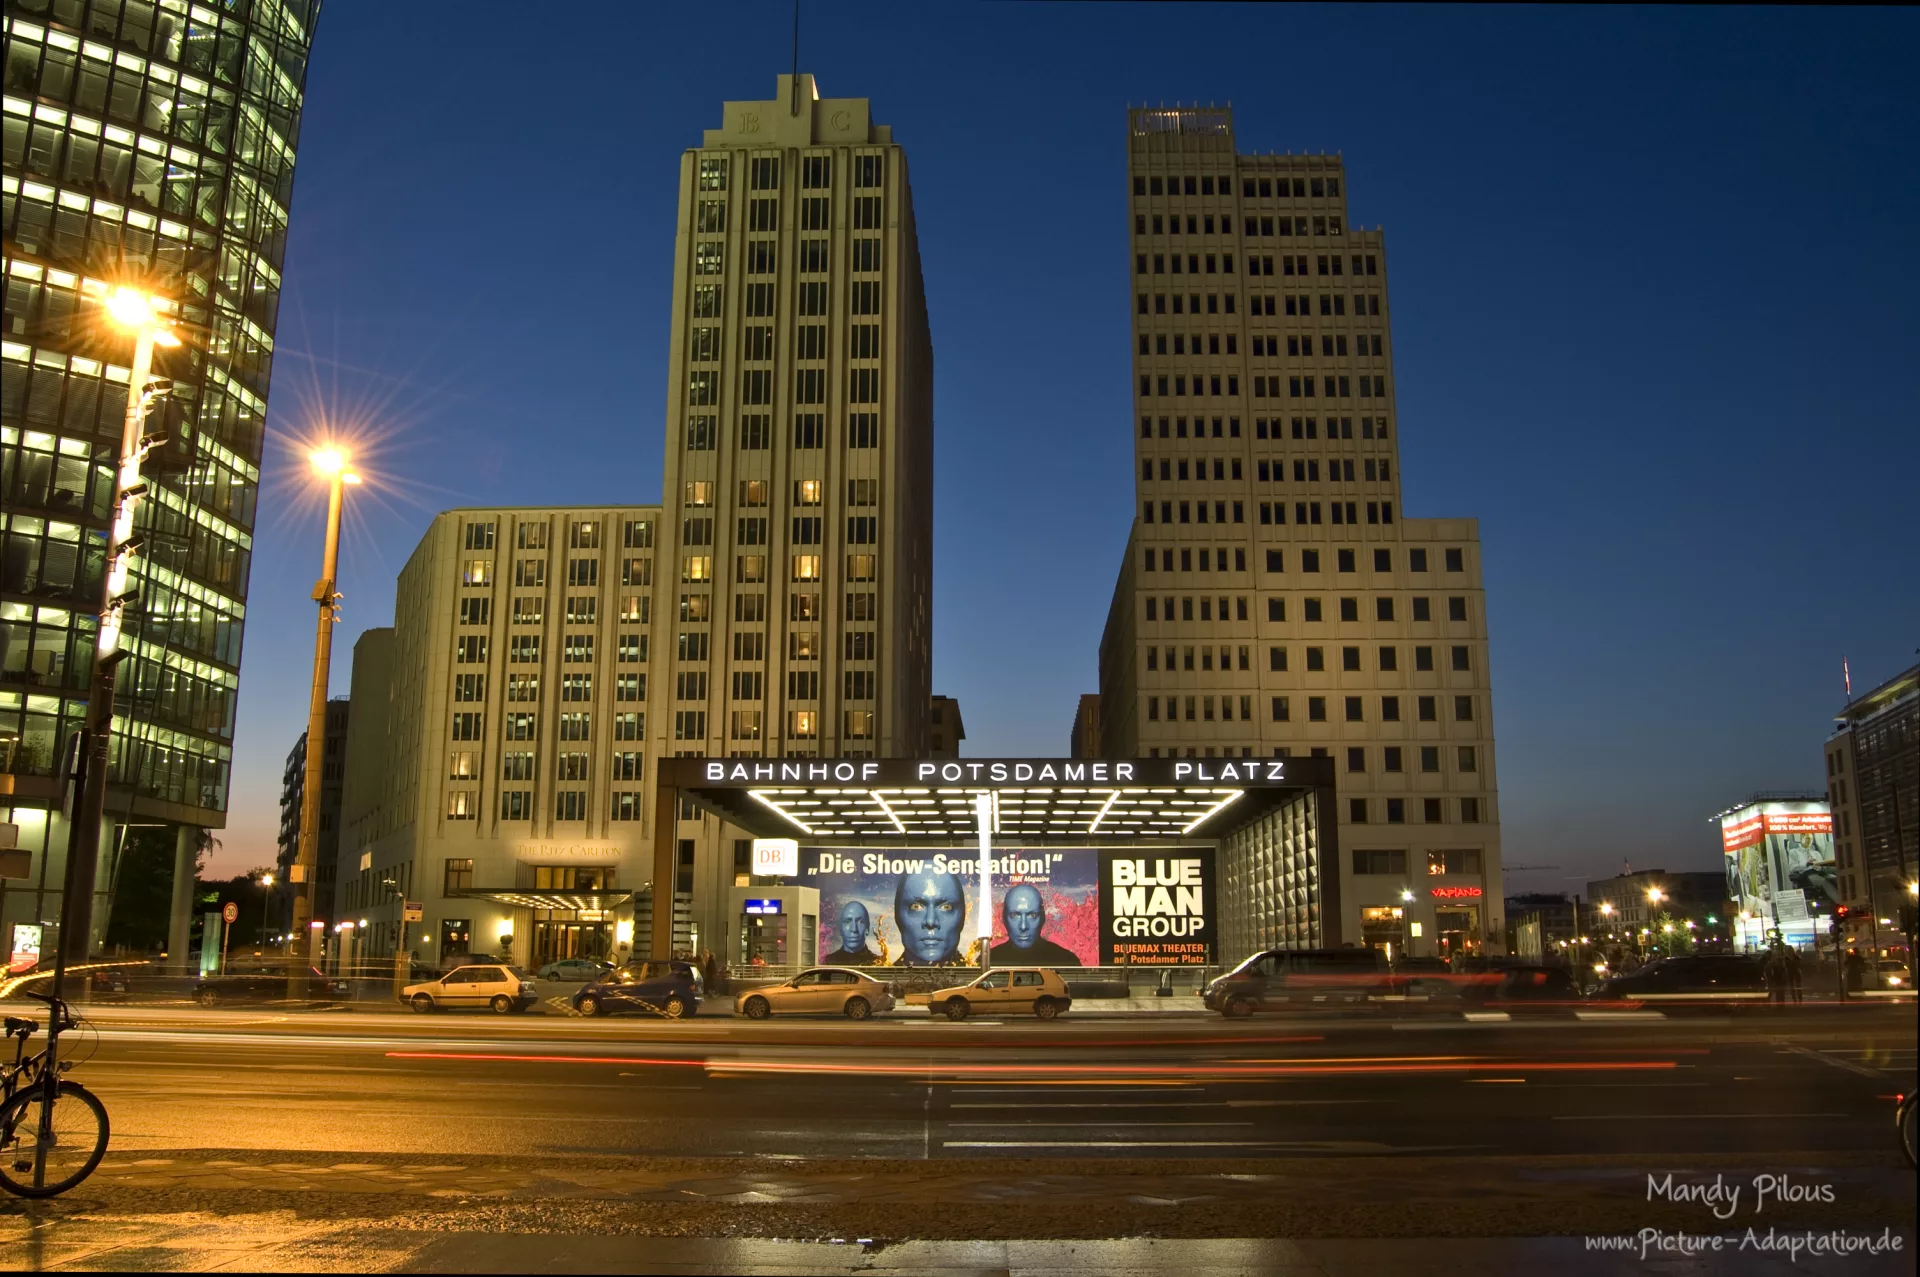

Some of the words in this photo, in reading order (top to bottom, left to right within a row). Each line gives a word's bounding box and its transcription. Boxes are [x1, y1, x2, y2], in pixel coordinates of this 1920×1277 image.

[739, 112, 759, 134] B
[831, 110, 850, 132] C
[706, 763, 879, 781] BAHNHOF
[918, 763, 1134, 781] POTSDAMER
[1175, 762, 1285, 780] PLATZ
[518, 844, 537, 856] THE
[760, 849, 781, 863] DB
[1112, 859, 1203, 886] BLUE
[1431, 887, 1482, 898] VAPIANO
[1113, 886, 1203, 916] MAN
[227, 908, 235, 917] 30
[1112, 917, 1204, 937] GROUP
[1113, 944, 1159, 953] BLUEMAX
[1162, 944, 1204, 953] THEATER
[1130, 955, 1179, 964] Potsdamer
[1181, 954, 1204, 964] Platz
